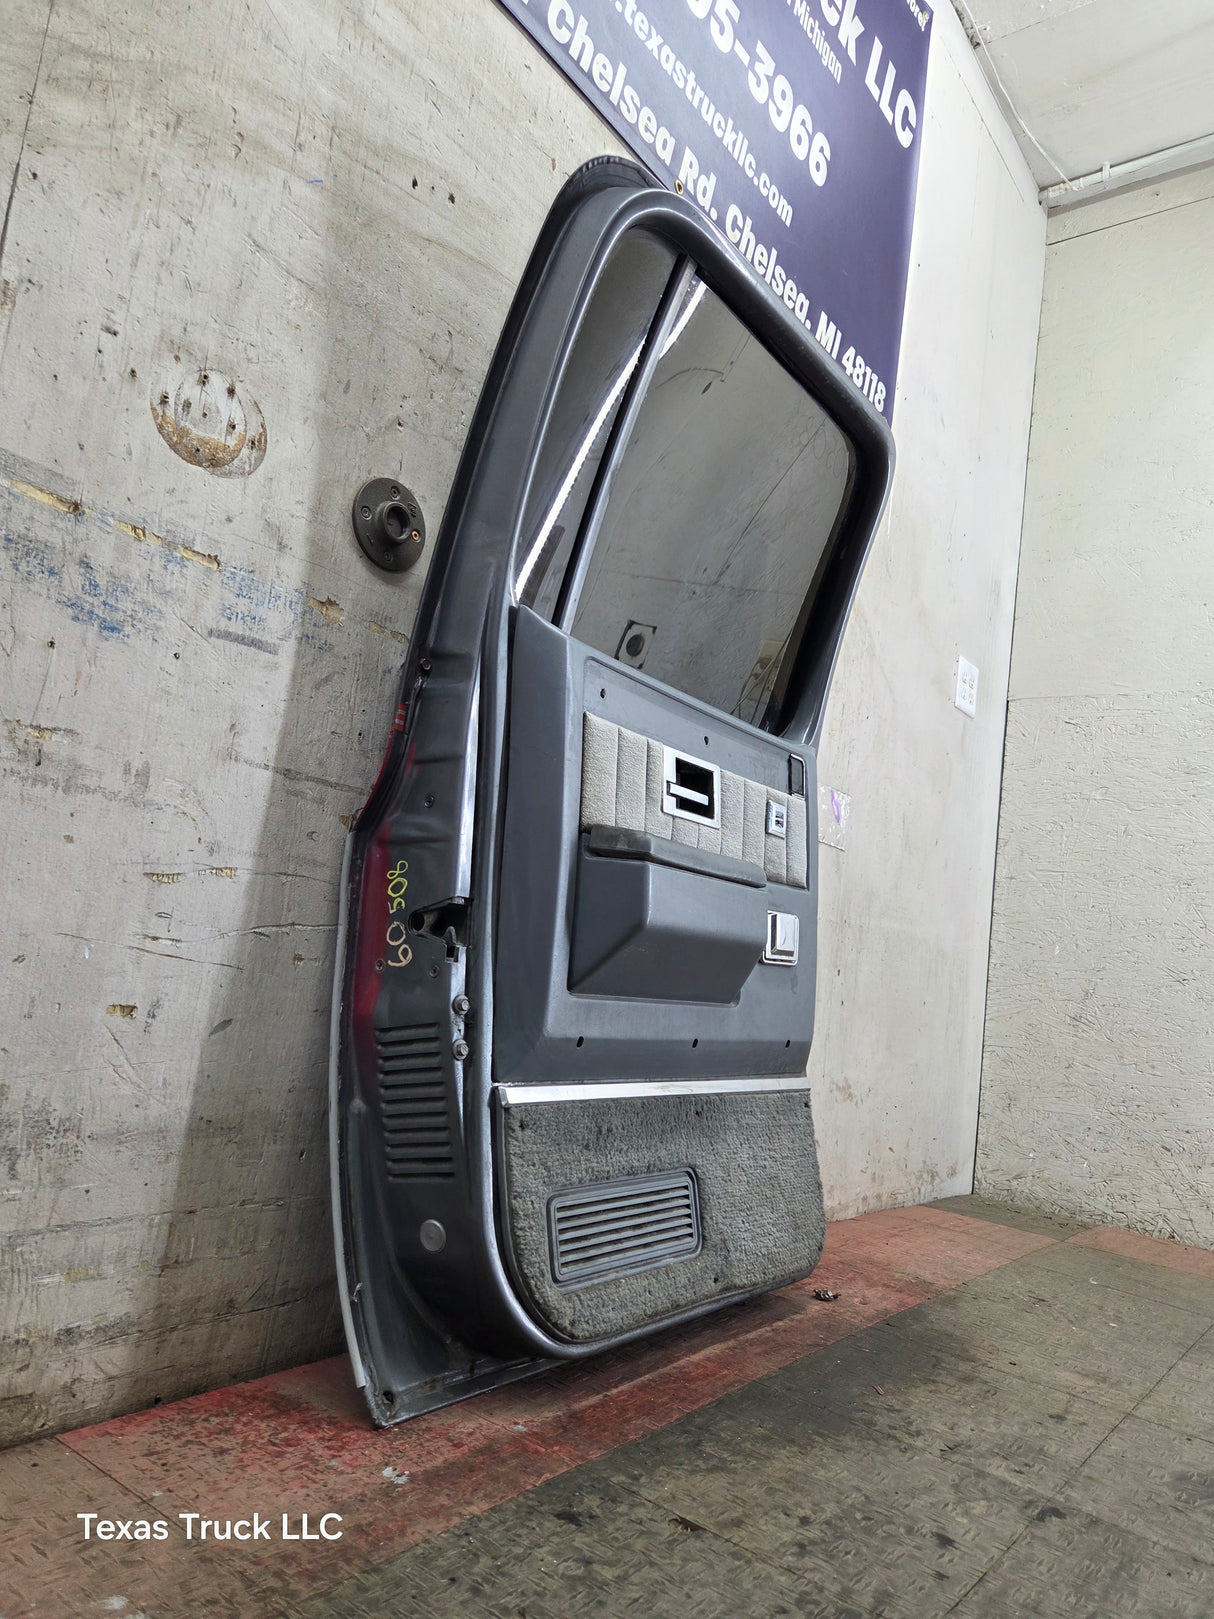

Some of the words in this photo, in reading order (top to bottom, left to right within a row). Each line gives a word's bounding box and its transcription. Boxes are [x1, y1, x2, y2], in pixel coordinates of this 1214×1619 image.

[793, 0, 842, 84] Michigan
[865, 35, 917, 148] LLC
[547, 0, 676, 166] Chelsea
[678, 145, 718, 221] Rd.
[815, 310, 842, 360] MI
[841, 346, 886, 413] 48118
